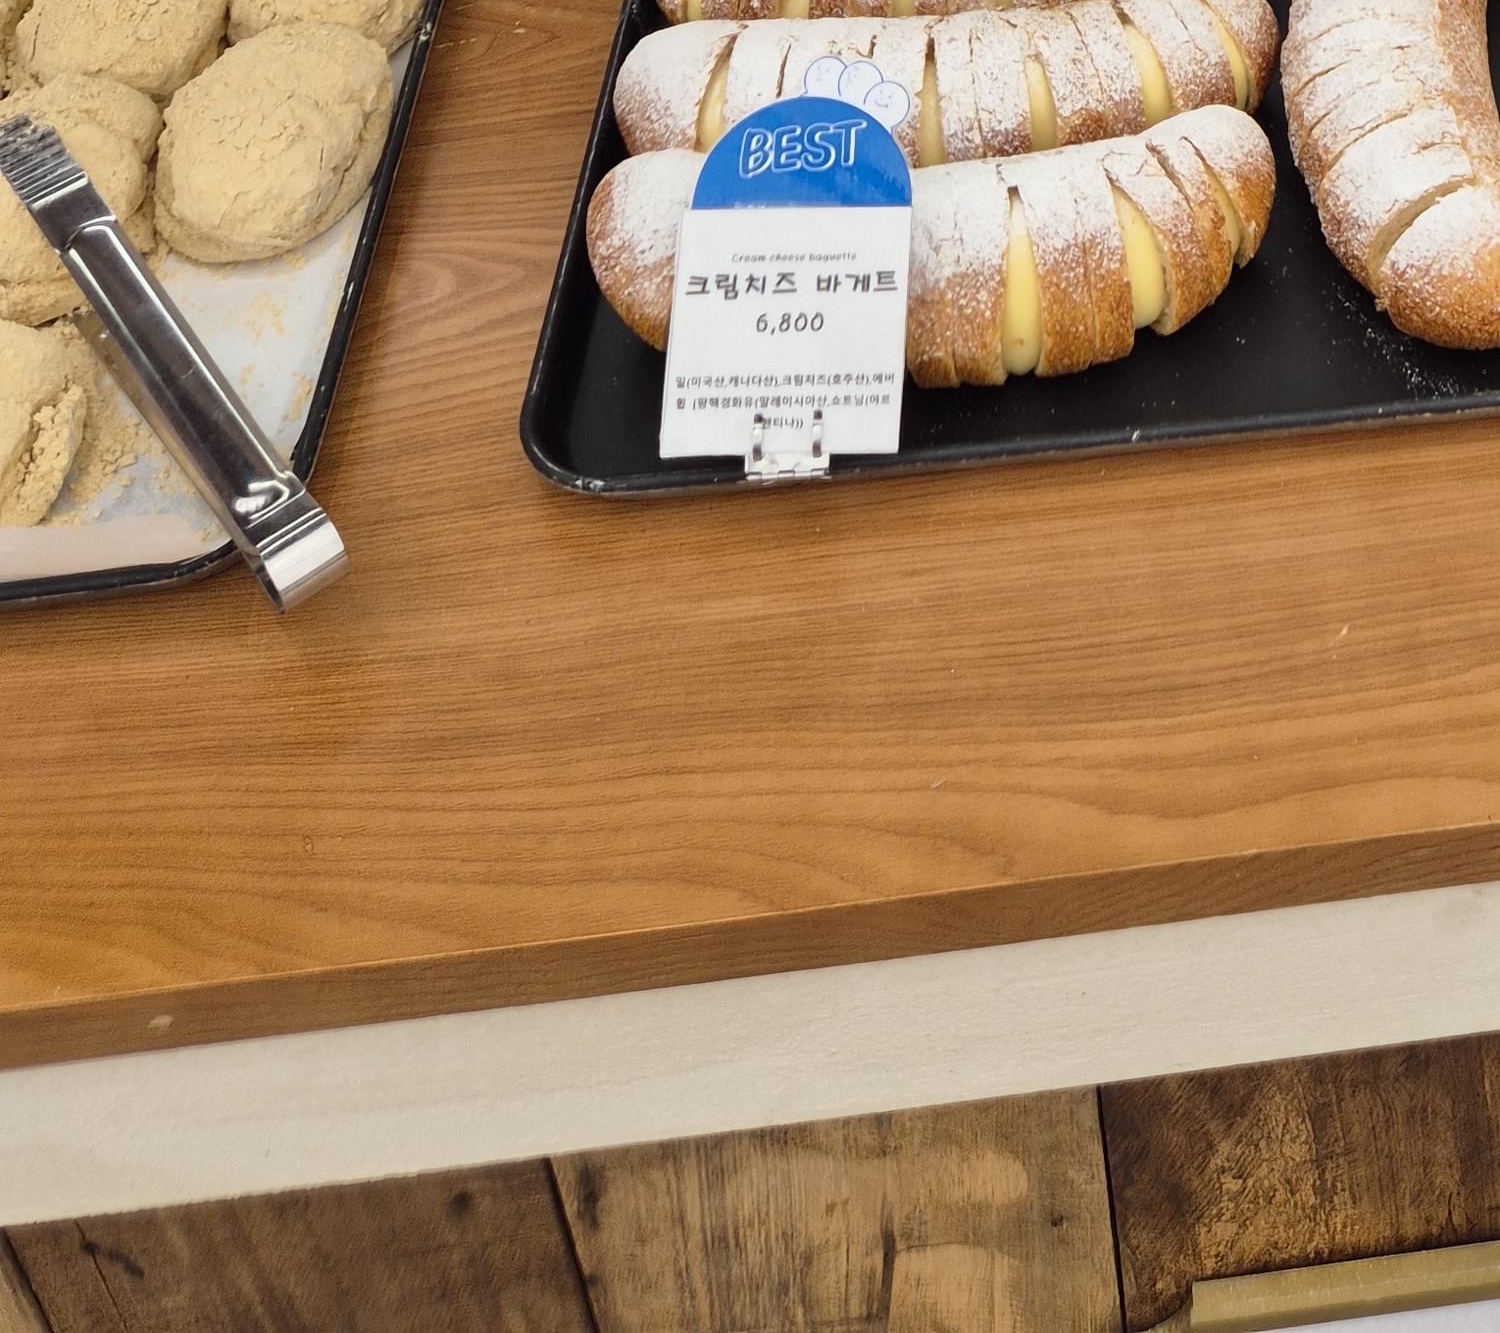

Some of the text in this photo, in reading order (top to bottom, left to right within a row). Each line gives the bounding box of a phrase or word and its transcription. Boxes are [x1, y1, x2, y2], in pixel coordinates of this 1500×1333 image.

[738, 119, 868, 179] BEST
[730, 251, 858, 263] Cream cheese baguette
[684, 270, 899, 302] 크림치즈 바게트
[755, 311, 825, 336] 6,800
